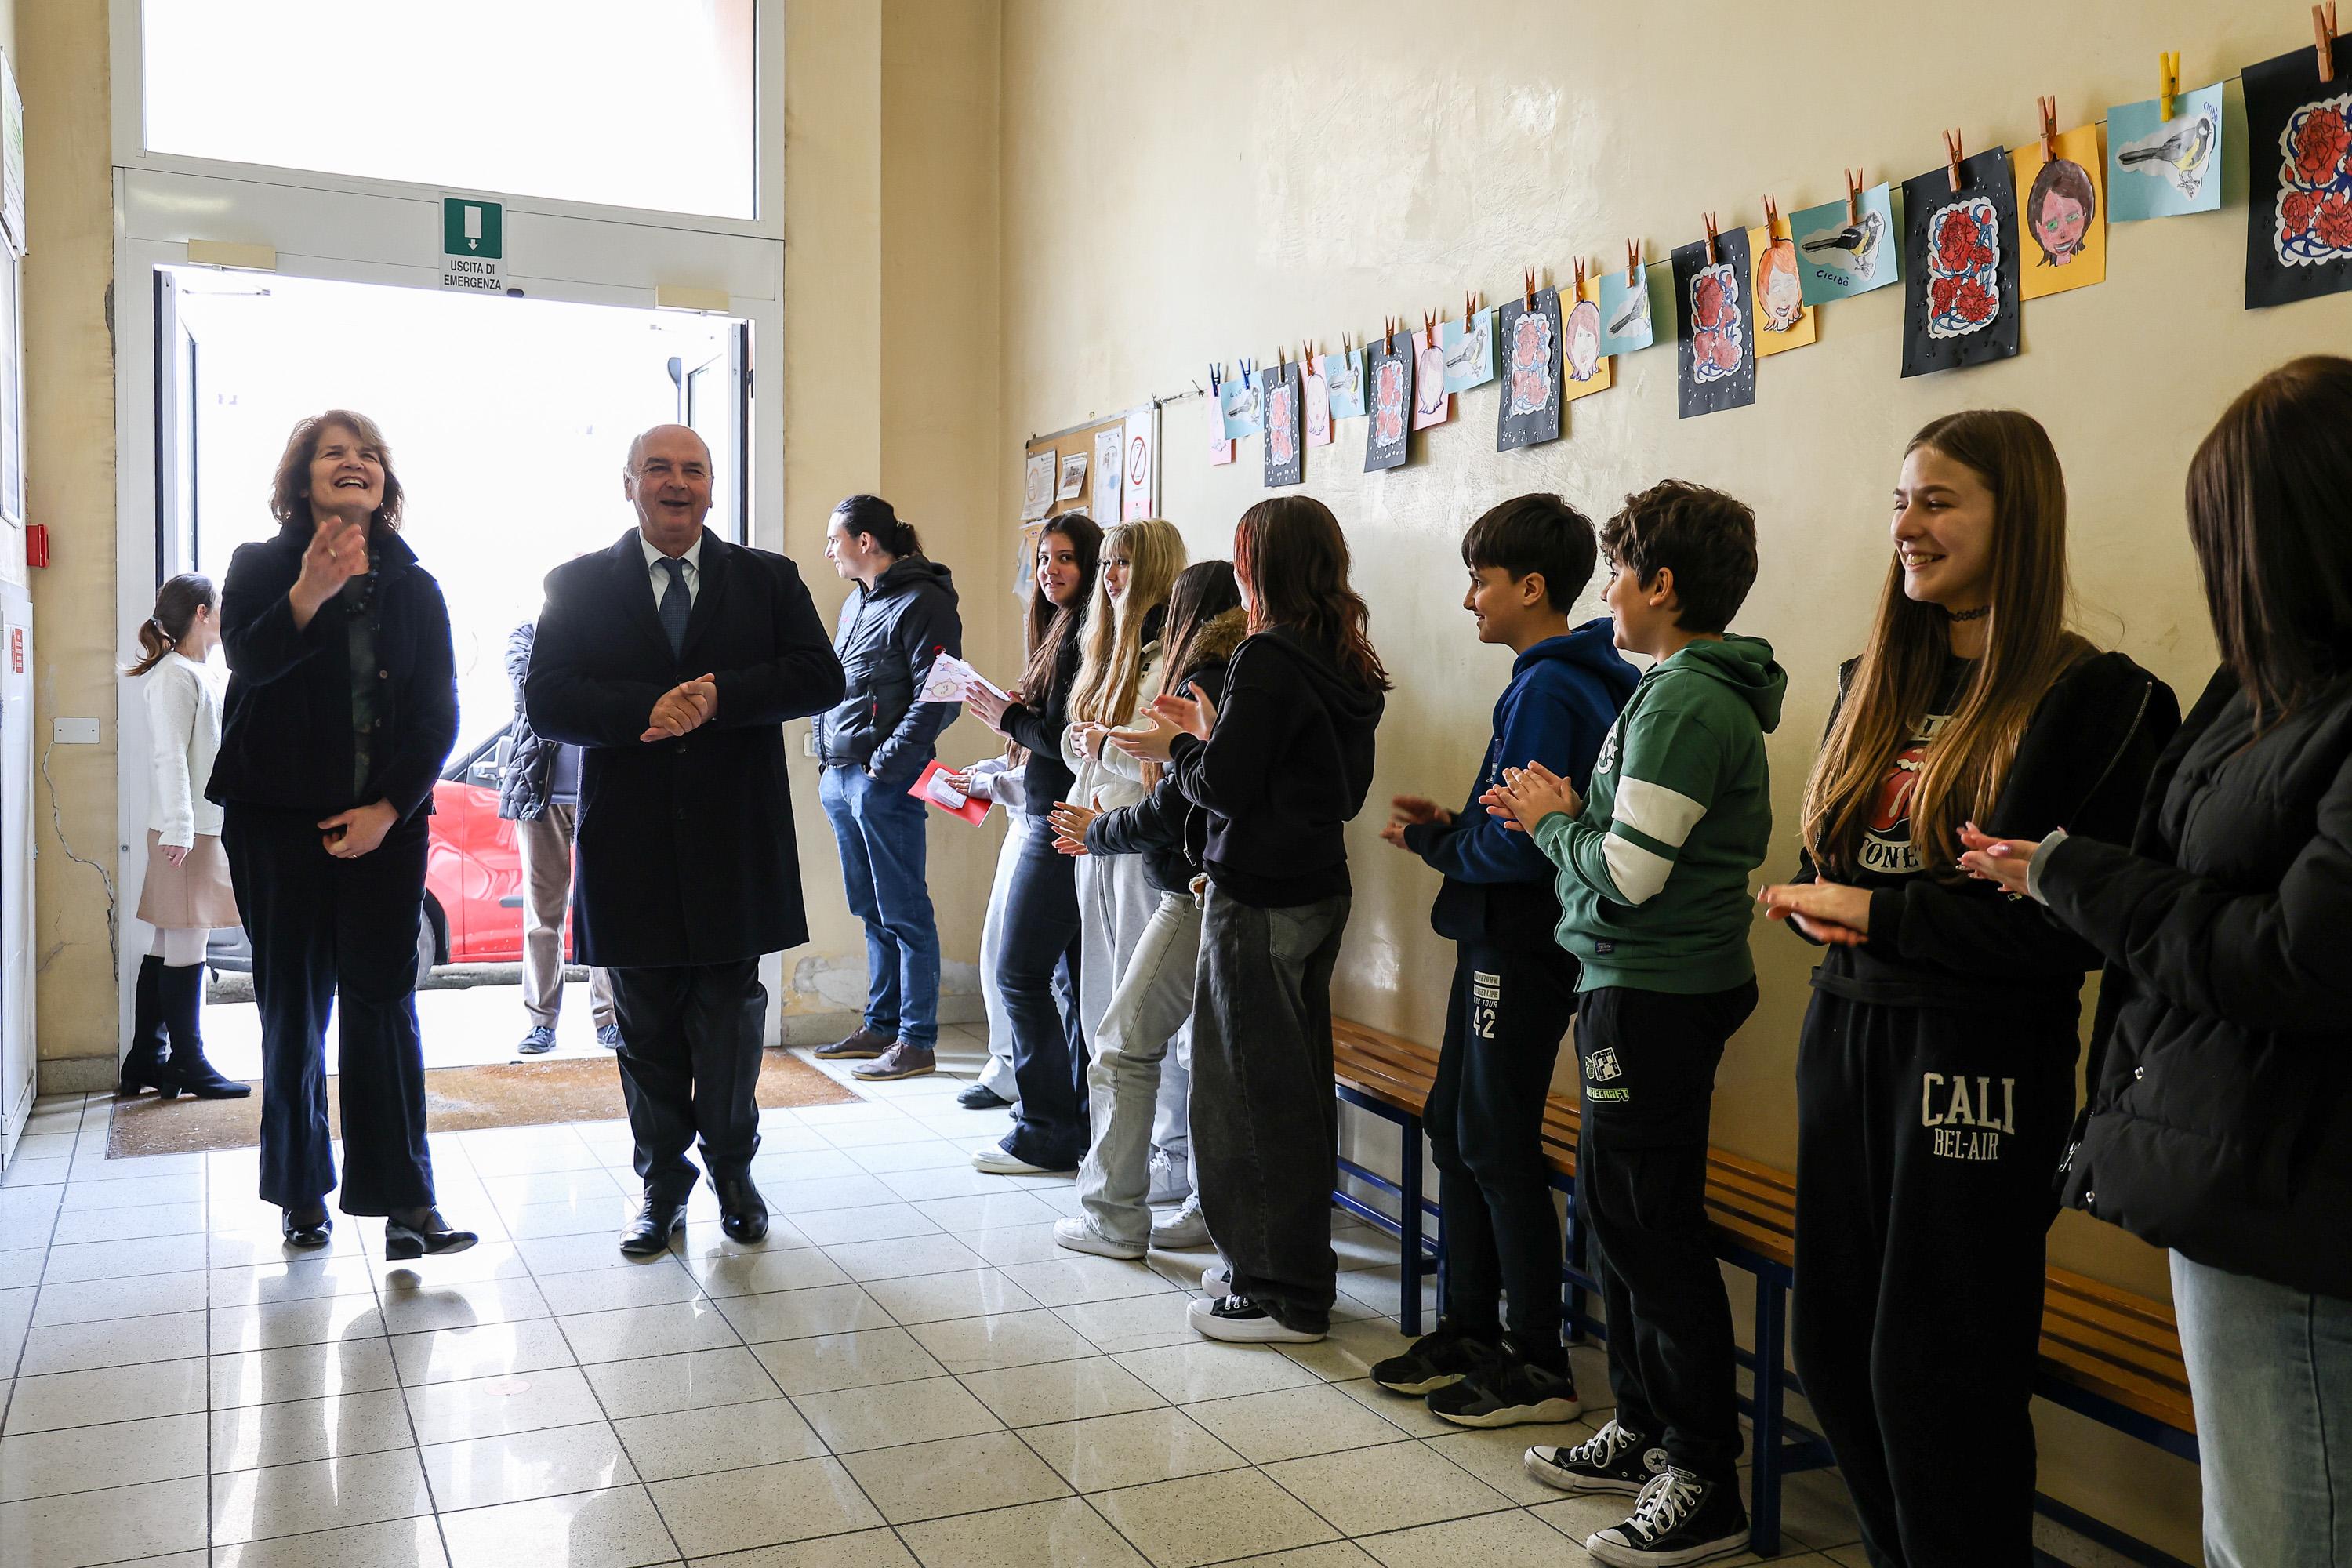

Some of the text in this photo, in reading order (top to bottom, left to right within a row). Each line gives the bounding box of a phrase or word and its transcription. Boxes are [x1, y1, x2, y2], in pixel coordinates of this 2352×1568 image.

[450, 260, 495, 275] USCITA DI
[444, 274, 502, 290] EMERGENZA
[1482, 999, 1498, 1008] TOUR
[1473, 1006, 1496, 1039] 42
[1922, 1071, 2015, 1135] CALI
[1933, 1127, 1999, 1160] BEL-AIR
